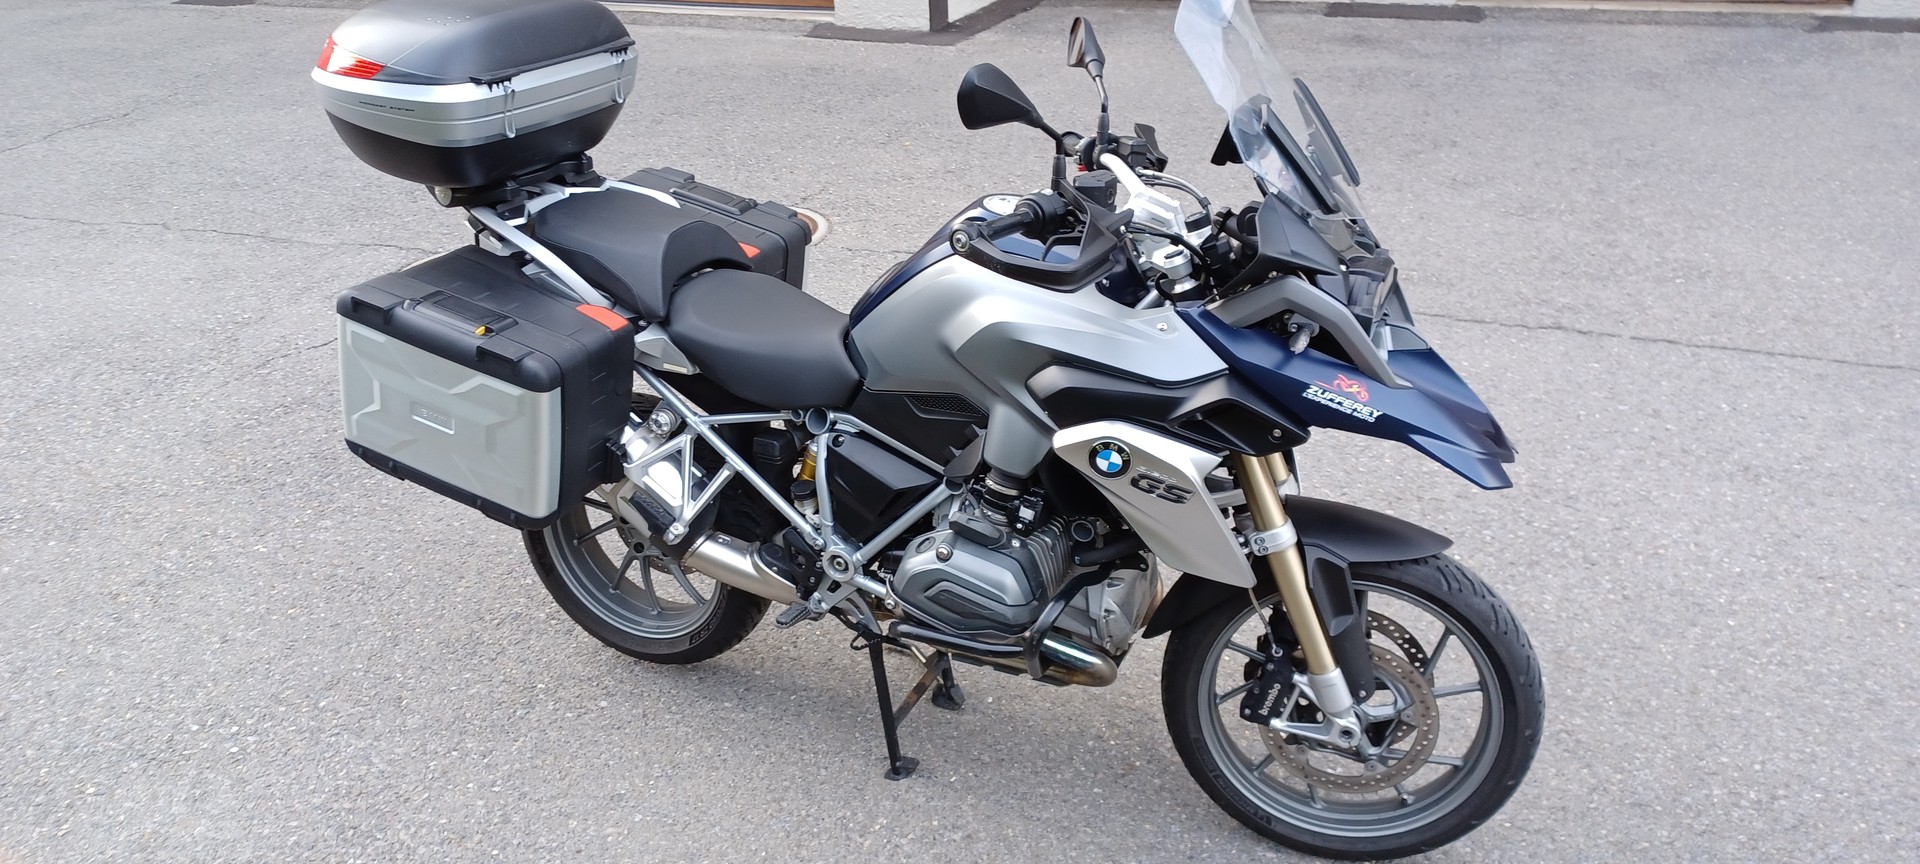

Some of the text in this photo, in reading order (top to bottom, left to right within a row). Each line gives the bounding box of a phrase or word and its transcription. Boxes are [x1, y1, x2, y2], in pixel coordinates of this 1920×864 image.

[1306, 385, 1383, 418] ZUFFEREY
[1352, 411, 1376, 423] MOTO
[1096, 444, 1130, 461] BMW
[1130, 473, 1194, 505] GS
[1258, 683, 1281, 716] brembo
